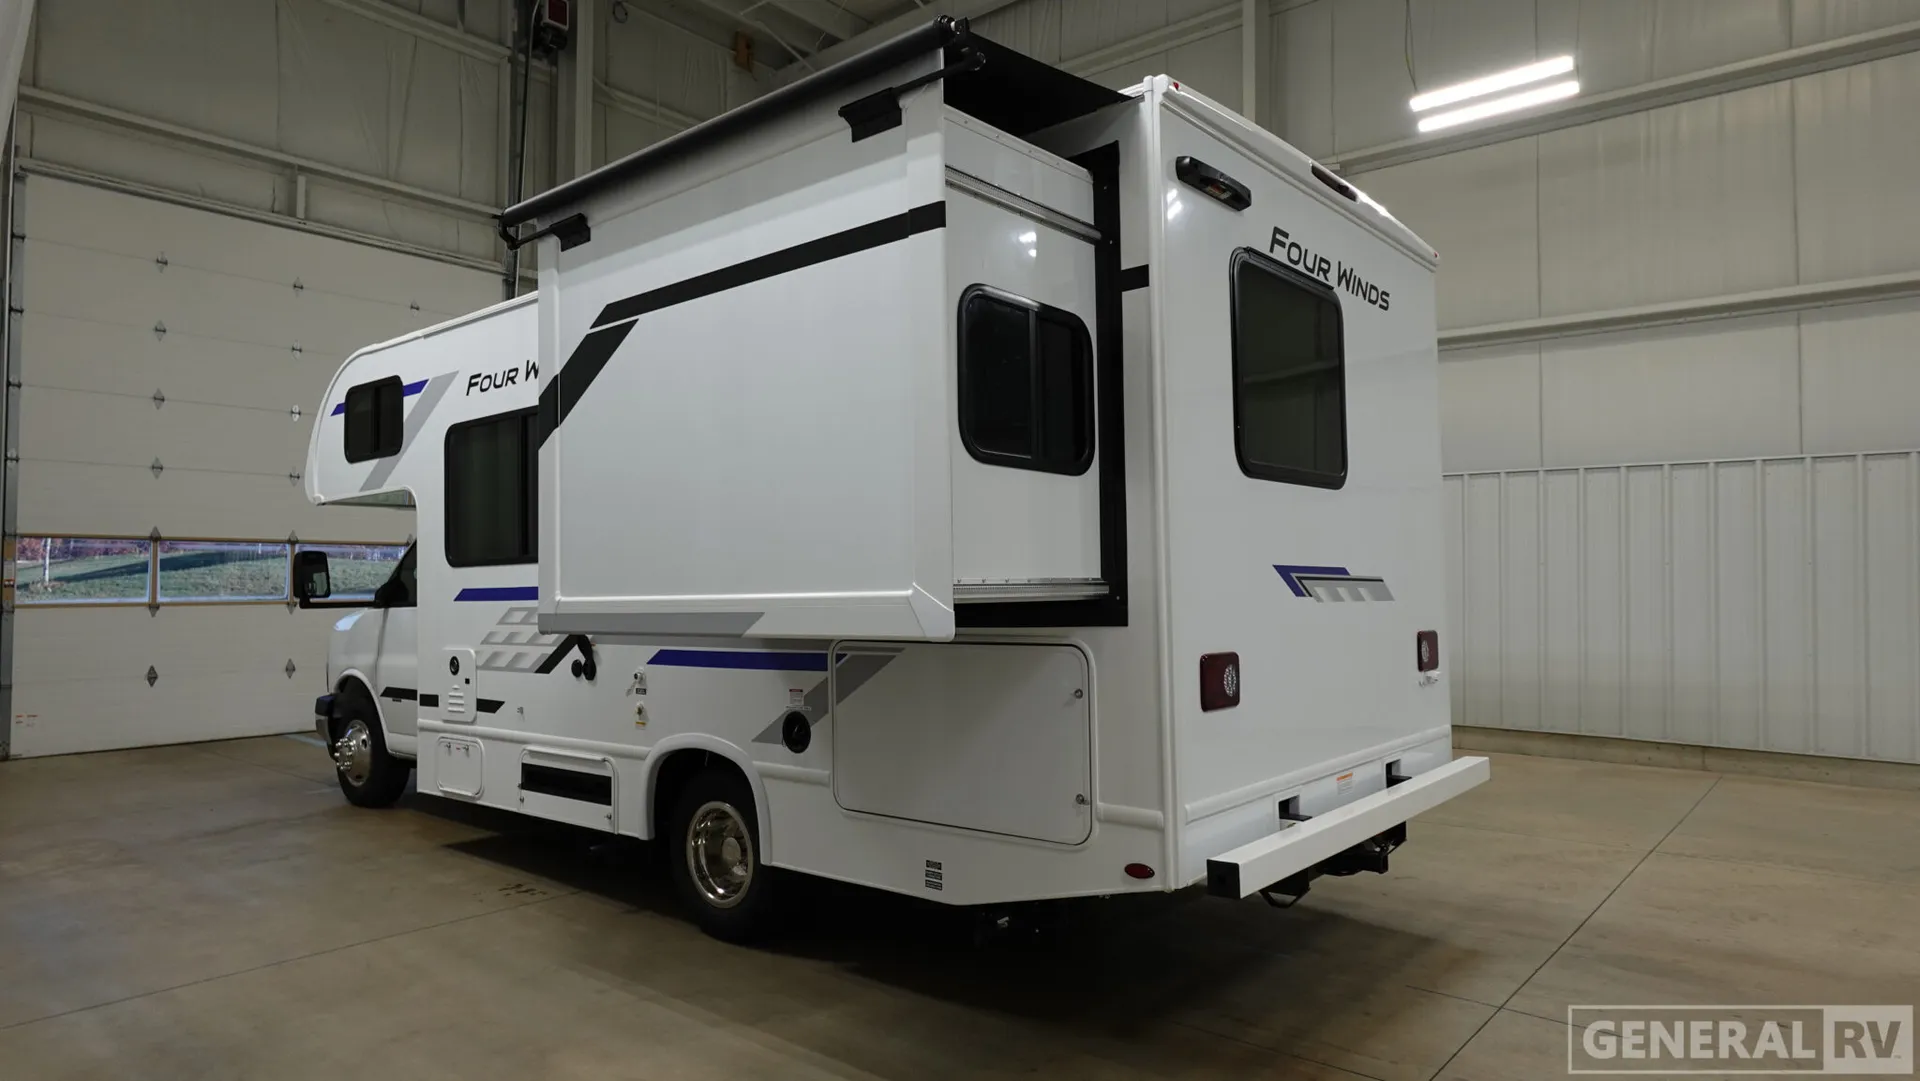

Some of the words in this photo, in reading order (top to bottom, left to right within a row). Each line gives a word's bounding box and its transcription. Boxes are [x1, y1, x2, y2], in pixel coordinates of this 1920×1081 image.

[1269, 226, 1331, 281] FOUR
[1337, 261, 1390, 311] WINDS
[466, 367, 519, 396] FOUR
